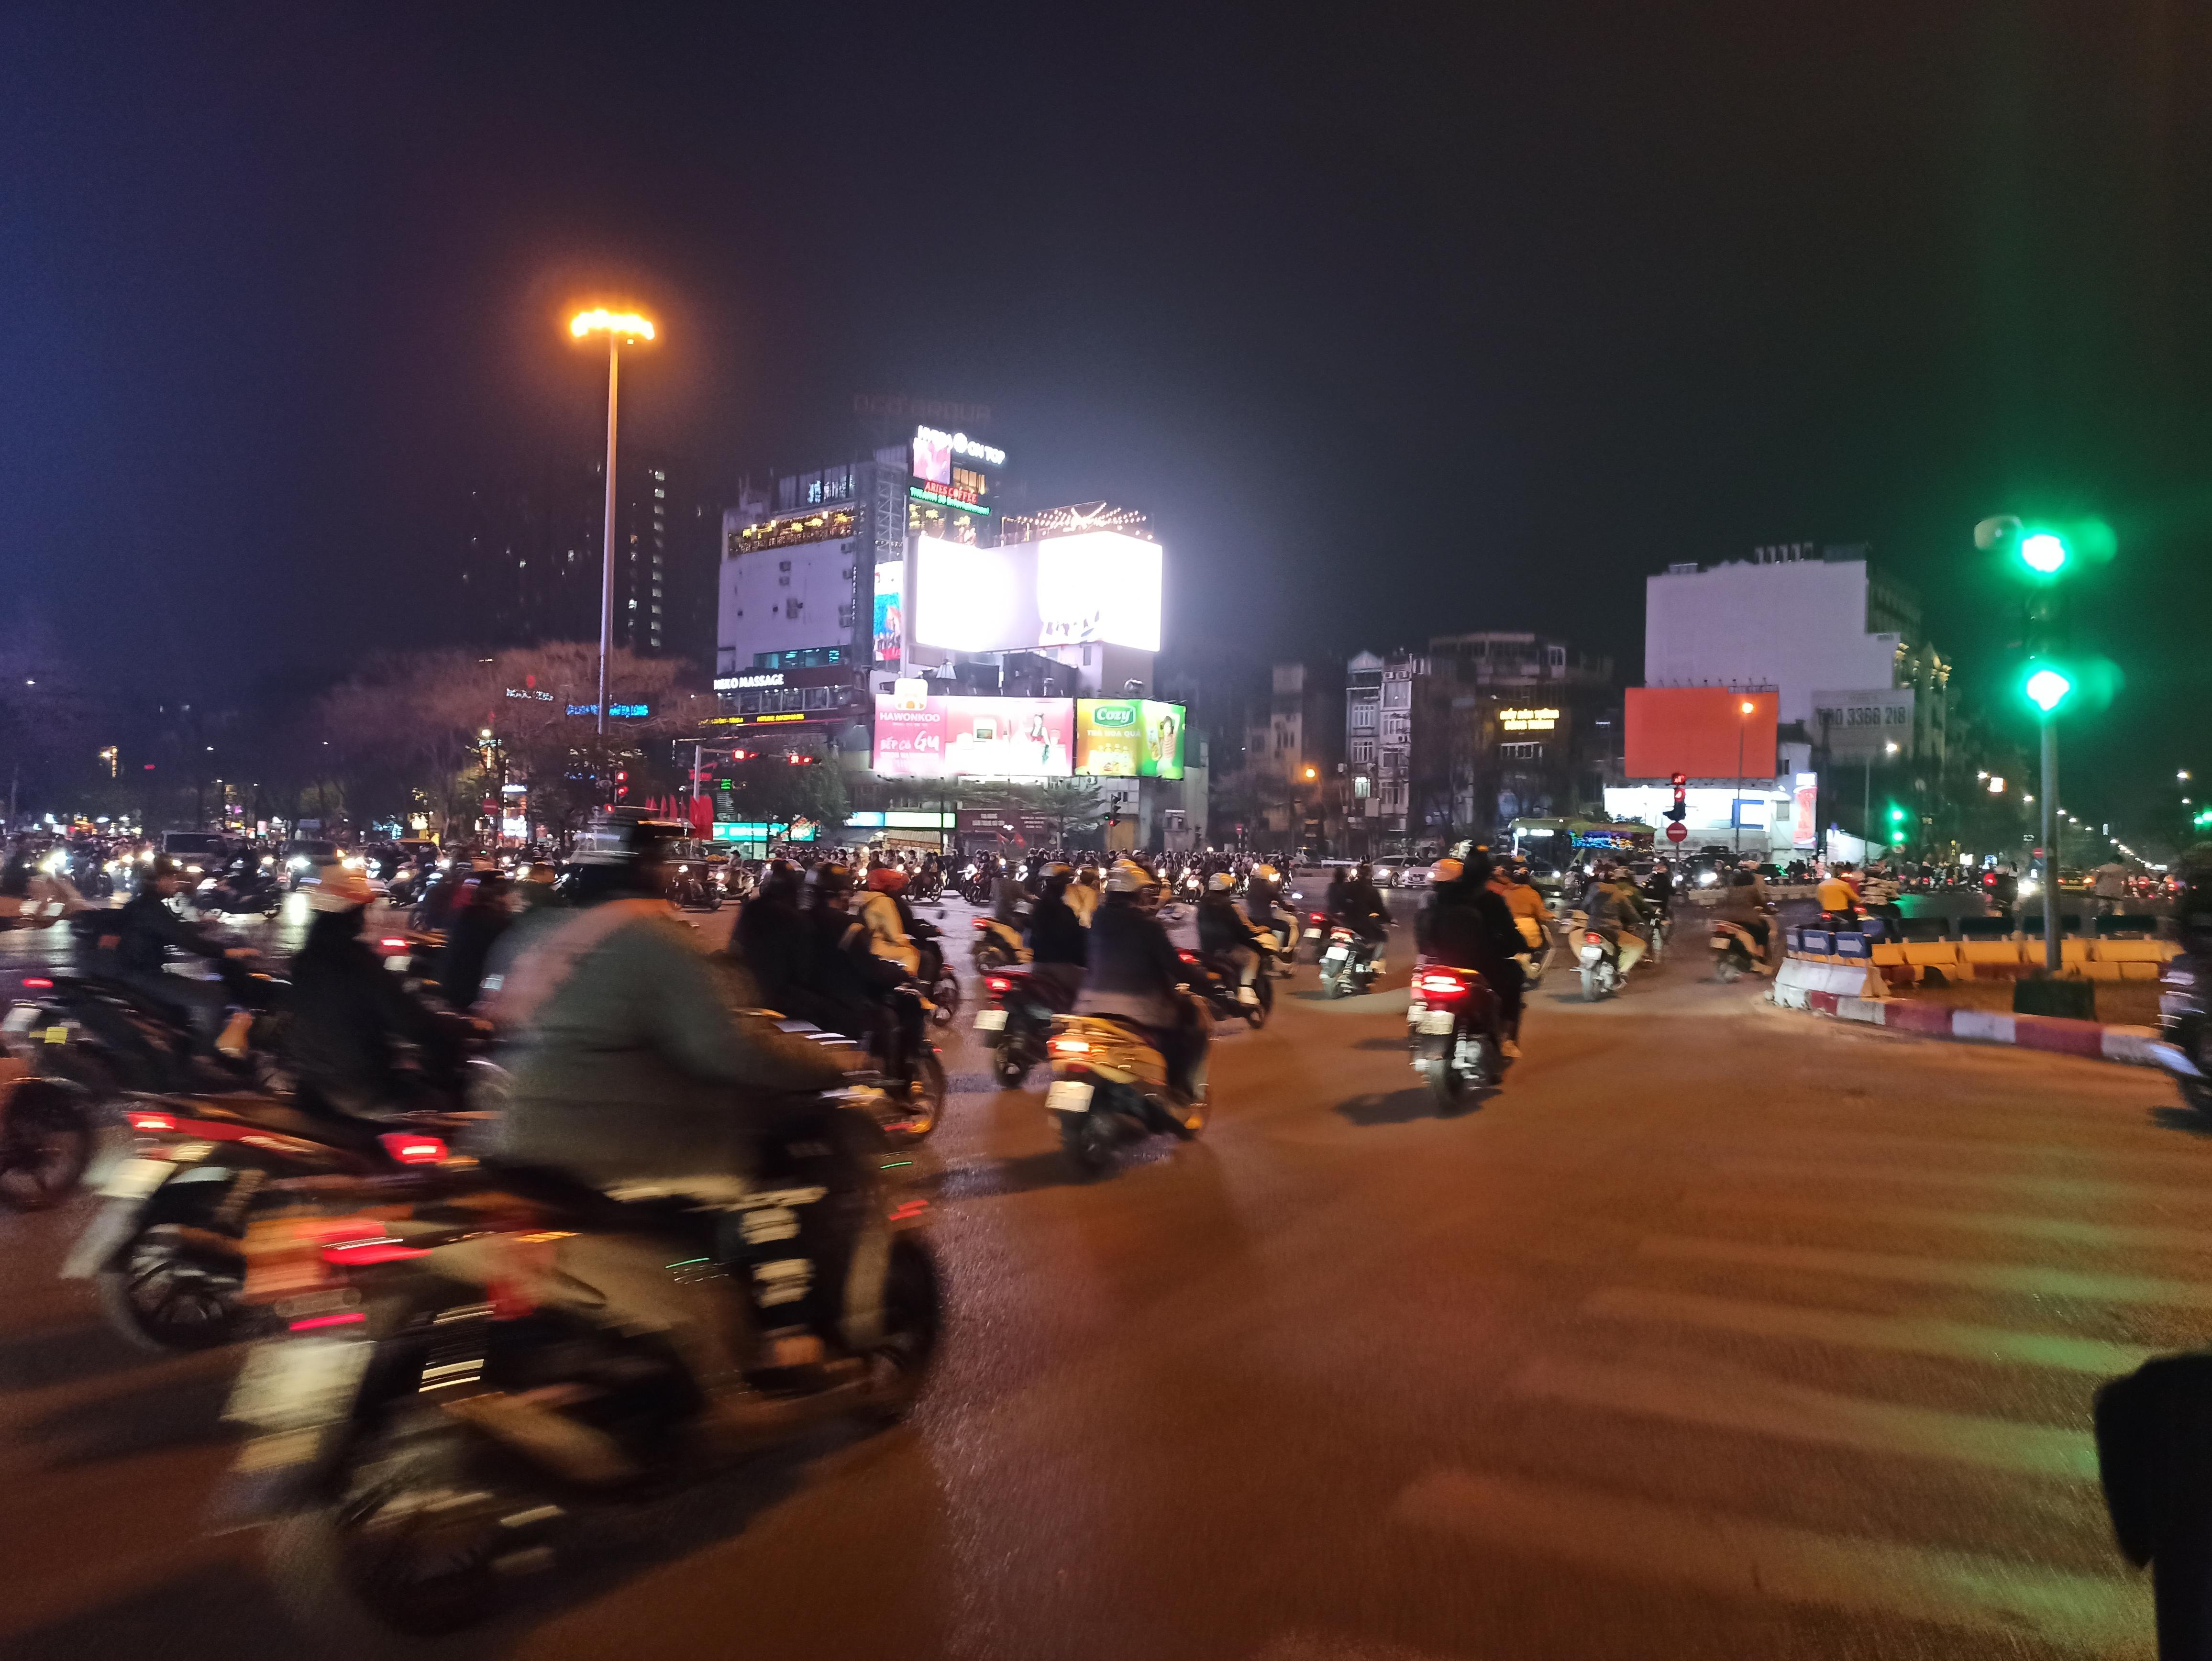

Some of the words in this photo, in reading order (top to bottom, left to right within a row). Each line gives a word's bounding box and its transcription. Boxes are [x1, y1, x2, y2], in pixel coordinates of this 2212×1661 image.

[925, 481, 948, 495] ARIES
[948, 487, 977, 503] COFFEE
[739, 674, 784, 688] MASSAGE
[880, 712, 940, 722] HAWONKOO
[1096, 708, 1131, 723] Cozy
